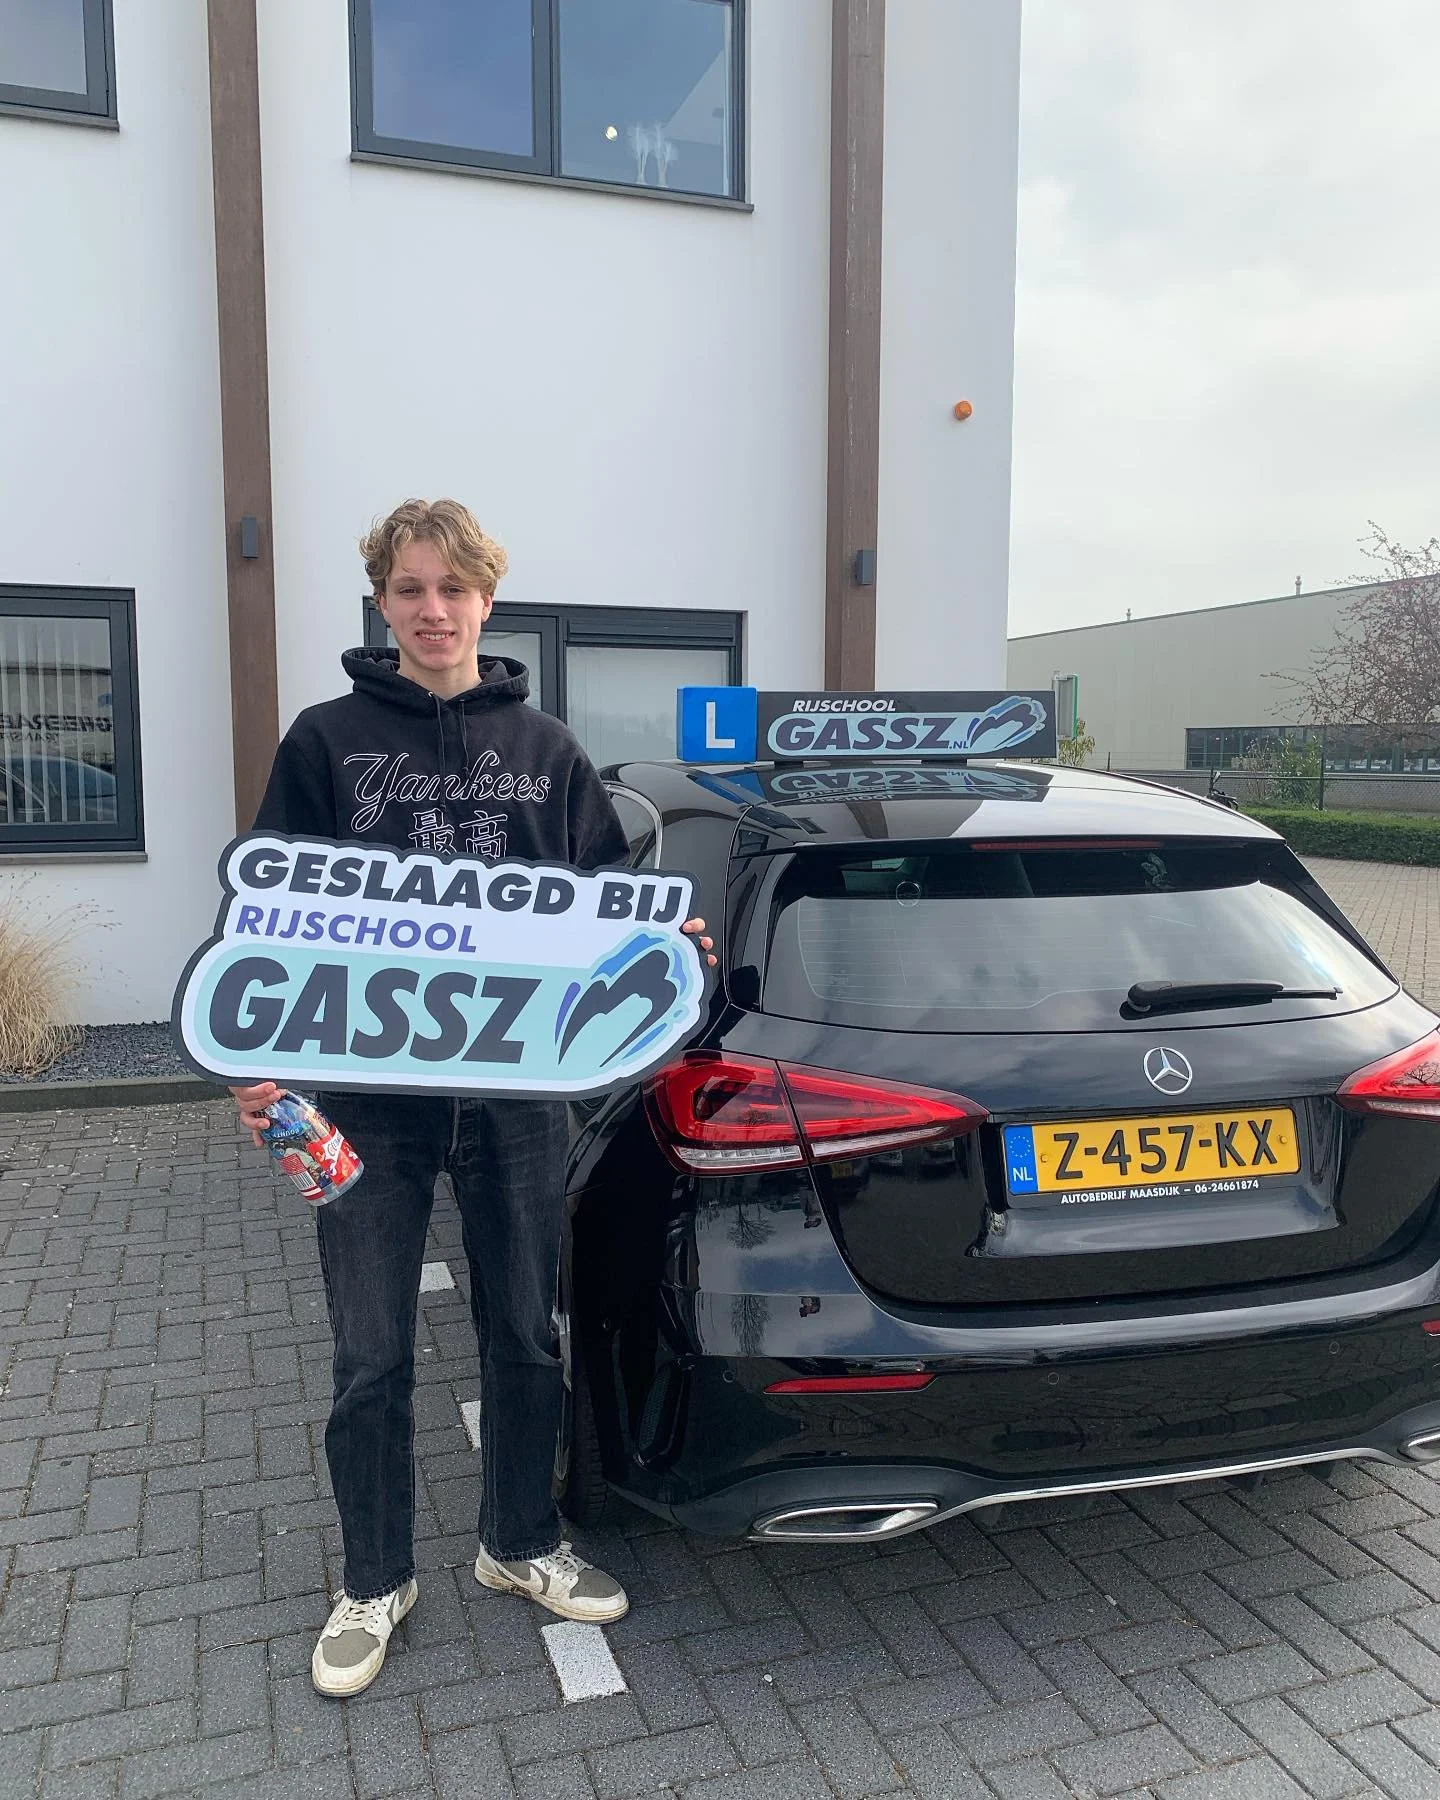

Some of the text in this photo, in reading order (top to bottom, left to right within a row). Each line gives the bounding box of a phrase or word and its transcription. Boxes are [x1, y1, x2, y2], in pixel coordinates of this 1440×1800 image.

[706, 701, 736, 749] L
[792, 699, 896, 712] RIJSCHOOL
[343, 749, 552, 833] Yankees
[408, 807, 508, 860] 最高
[238, 847, 683, 924] GESLAAGD BIJ
[235, 904, 477, 953] RIJSCHOOL
[208, 955, 543, 1065] GASSZ
[1012, 1166, 1034, 1182] NL
[1053, 1118, 1278, 1180] Z-457-KX
[1061, 1189, 1127, 1204] AUTOBEDRIJF
[1130, 1185, 1180, 1199] MAASDIJK
[1195, 1179, 1259, 1194] 06-24661874
